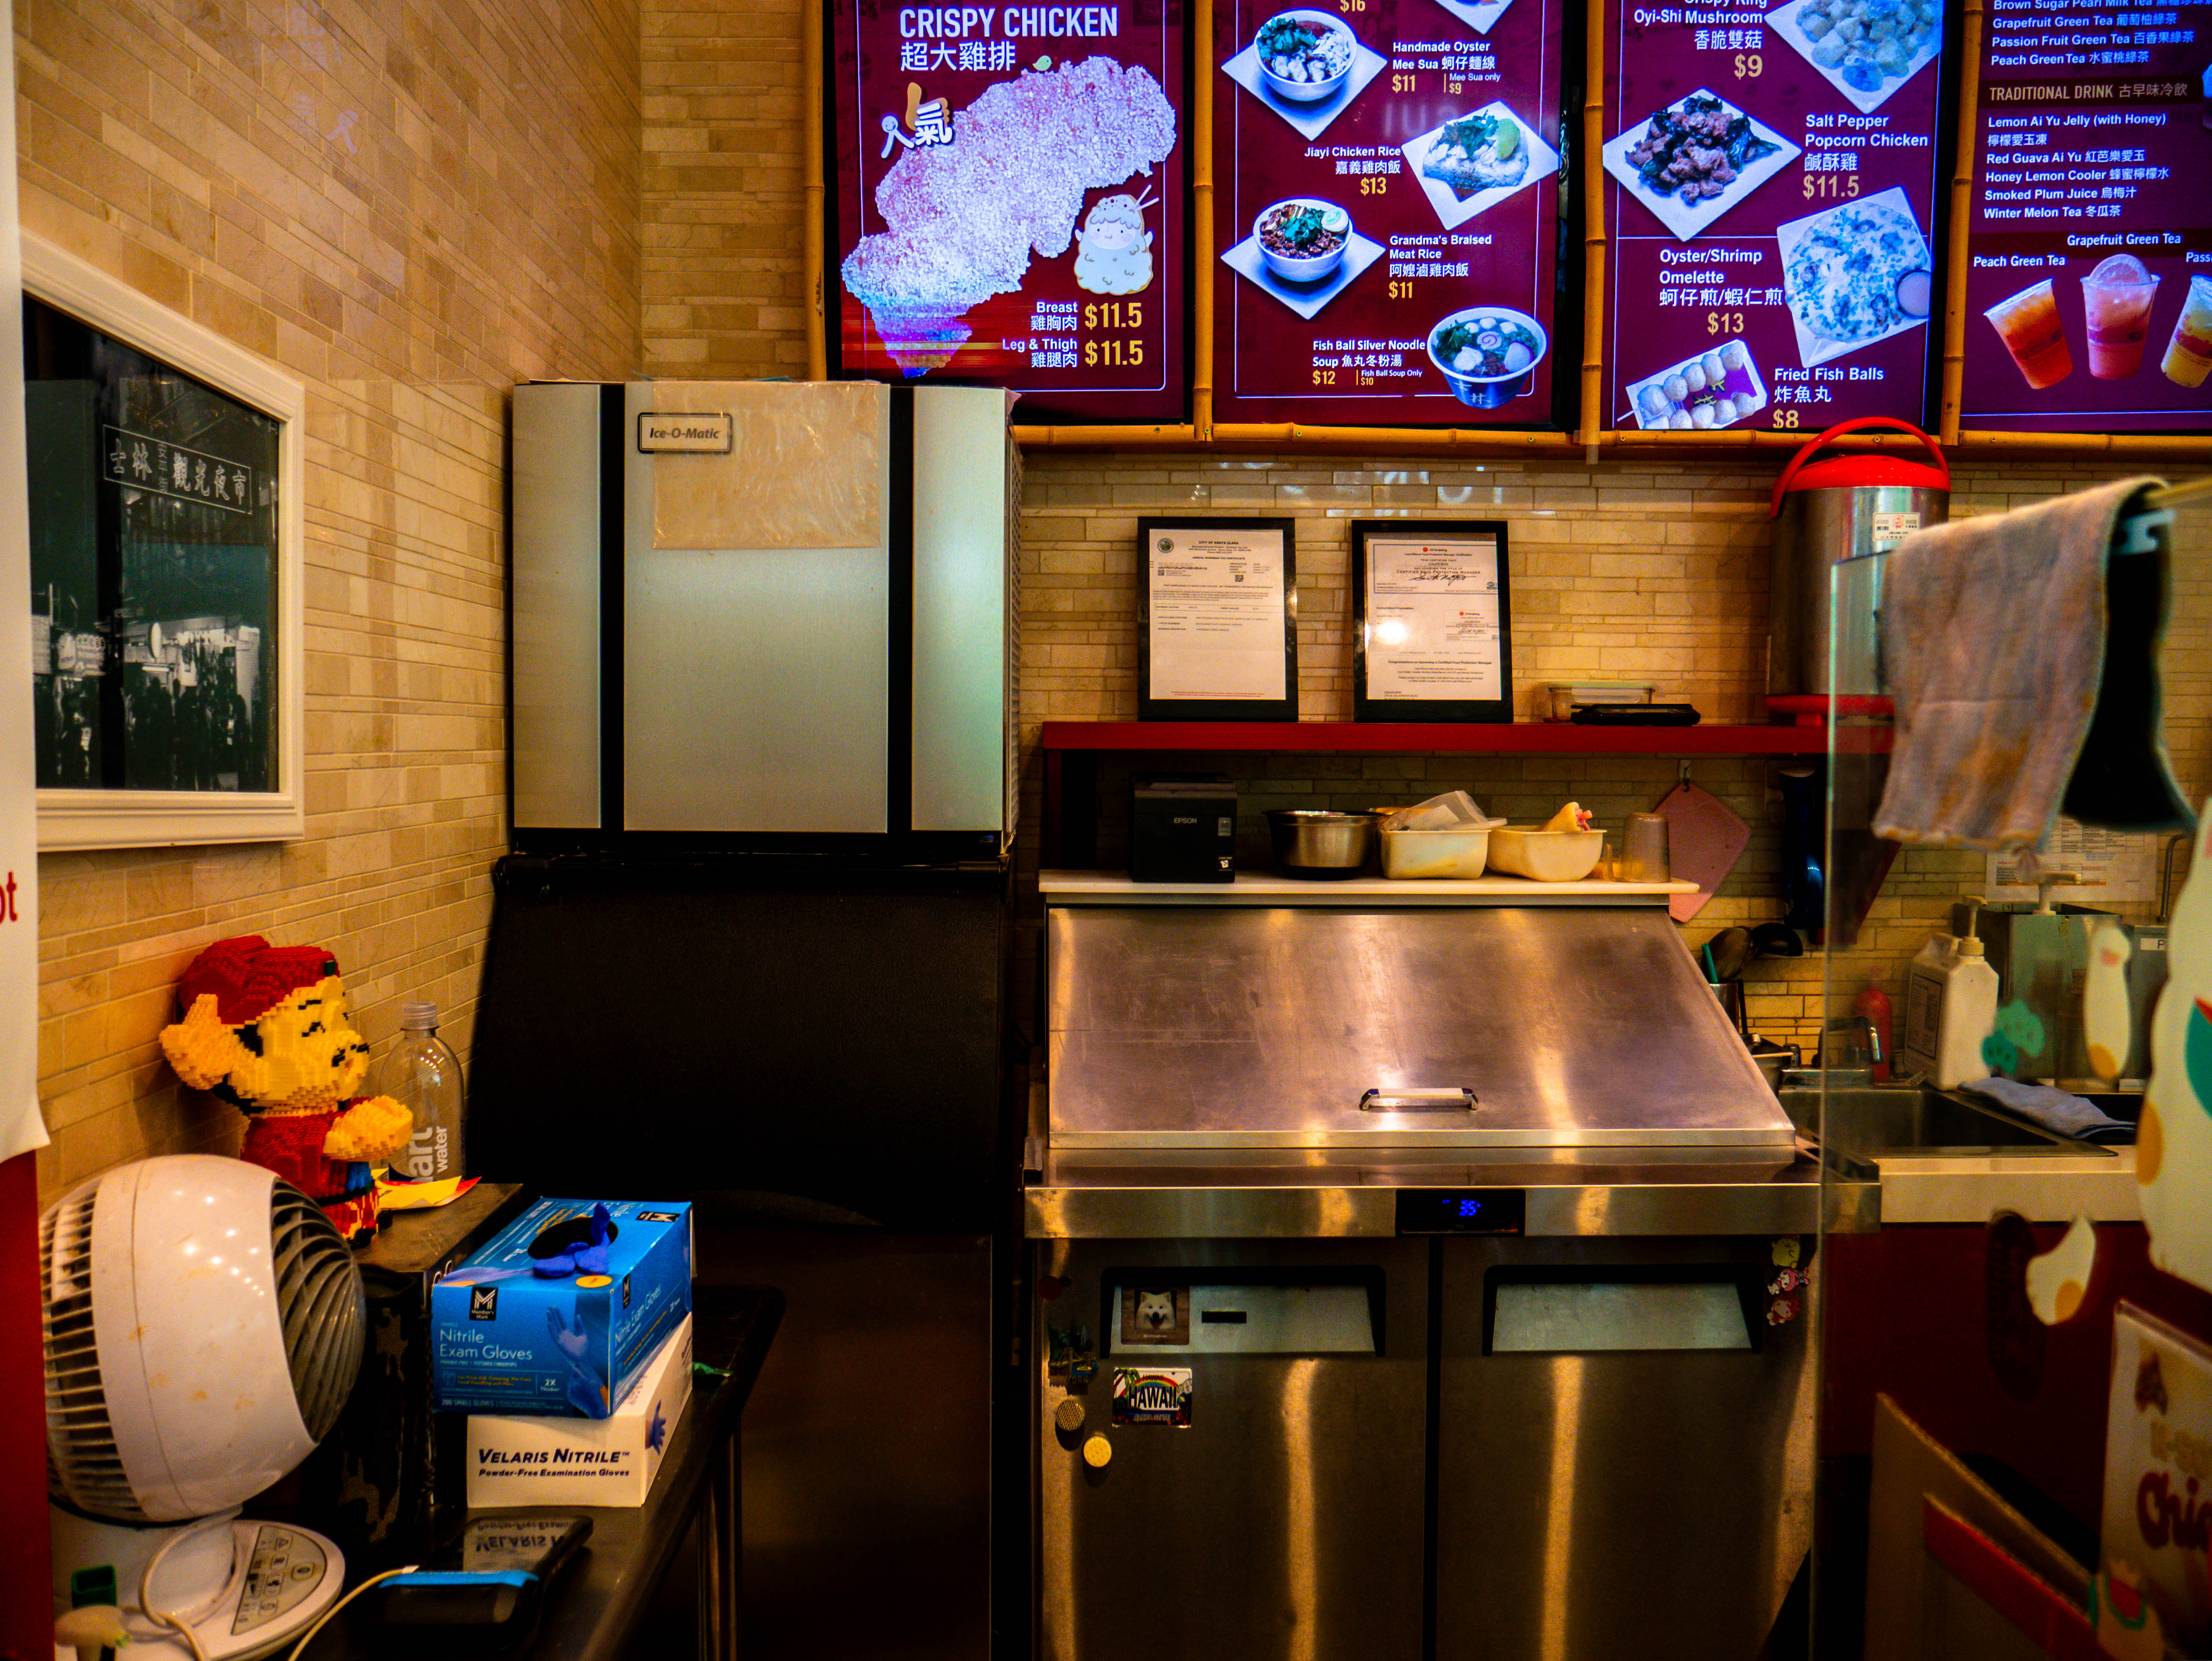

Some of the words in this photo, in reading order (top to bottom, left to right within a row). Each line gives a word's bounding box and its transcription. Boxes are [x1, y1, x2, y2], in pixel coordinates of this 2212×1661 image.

[1340, 0, 1365, 13] $16
[1994, 0, 2031, 10] Brown
[2035, 0, 2069, 11] Sugar
[901, 8, 995, 37] CRISPY
[1004, 7, 1117, 36] CHICKEN
[1634, 9, 1681, 26] Oyi-Shi
[1686, 11, 1762, 23] Mushroom
[1993, 17, 2051, 30] Grapefruit
[2055, 16, 2089, 26] Green
[2093, 16, 2112, 25] Tea
[2117, 13, 2176, 26] 葡萄柚綠茶
[1694, 30, 1762, 49] 香脆雙菇
[1992, 37, 2037, 46] Passion
[2042, 36, 2068, 45] Fruit
[2072, 35, 2106, 44] Green
[2111, 34, 2129, 44] Tea
[2135, 31, 2193, 44] 百香果綠茶
[1394, 42, 1451, 52] Handmade
[1454, 42, 1490, 54] Oyster
[901, 41, 1015, 71] 超大雞排
[1393, 59, 1414, 69] Mee
[1418, 59, 1438, 69] Sua
[1442, 56, 1495, 70] 蚵仔麵線
[1991, 55, 2026, 65] Peach
[2030, 54, 2064, 64] Green
[2066, 54, 2085, 63] Tea
[2090, 51, 2149, 64] 水蜜桃綠茶
[1735, 54, 1762, 79] $9
[1392, 74, 1415, 93] $11
[1485, 73, 1500, 82] only
[1449, 83, 1461, 94] $9
[1990, 86, 2069, 100] TRADITIONAL
[2075, 85, 2112, 98] DRINK
[2119, 83, 2187, 97] 古早味冷飲
[1806, 115, 1833, 127] Salt
[1838, 115, 1888, 130] Pepper
[1989, 118, 2027, 127] Lemon
[2031, 117, 2042, 126] Ai
[2046, 116, 2060, 125] Yu
[2064, 116, 2090, 127] Jelly
[2094, 115, 2121, 126] (with
[2125, 114, 2166, 125] Honey)
[881, 103, 952, 159] 人氣
[1806, 134, 1865, 149] Popcorn
[1871, 134, 1928, 146] Chicken
[1988, 133, 2047, 146] 檸檬愛玉凍
[1305, 147, 1329, 159] Jiayi
[1332, 147, 1375, 156] Chicken
[1379, 146, 1402, 156] Rice
[1987, 154, 2009, 163] Red
[2013, 153, 2049, 163] Guava
[2052, 152, 2064, 162] Ai
[2068, 152, 2081, 162] Yu
[2085, 150, 2145, 162] 紅芭樂愛玉
[1336, 160, 1400, 174] 嘉義雞肉飯
[1805, 152, 1858, 171] 鹹酥雞
[1986, 172, 2022, 184] Honey
[2026, 171, 2064, 181] Lemon
[2068, 170, 2107, 180] Cooler
[2110, 167, 2168, 180] 蜂蜜檸檬水
[1361, 178, 1386, 195] $13
[1803, 174, 1859, 200] $11.5
[1985, 190, 2031, 200] Smoked
[2035, 189, 2063, 199] Plum
[2067, 189, 2097, 198] Juice
[2101, 187, 2137, 198] 烏梅汁
[1984, 208, 2021, 218] Winter
[2025, 208, 2058, 217] Melon
[2063, 207, 2081, 216] Tea
[2086, 205, 2121, 217] 冬瓜茶
[1390, 235, 1447, 245] Grandma's
[1451, 235, 1491, 244] Braised
[2067, 235, 2123, 248] Grapefruit
[2126, 234, 2158, 244] Green
[2163, 234, 2180, 243] Tea
[1390, 249, 1415, 259] Meat
[1419, 249, 1441, 258] Rice
[1660, 249, 1762, 265] Oyster/Shrimp
[1974, 256, 2006, 267] Peach
[2011, 256, 2042, 266] Green
[2047, 255, 2065, 265] Tea
[1390, 263, 1469, 277] 阿嬤滷雞肉飯
[1660, 271, 1724, 283] Omelette
[1389, 281, 1412, 299] $11
[1660, 288, 1783, 306] 蚵仔煎/蝦仁煎
[1037, 302, 1078, 312] Breast
[1031, 315, 1076, 330] 雞胸肉
[1085, 303, 1142, 329] $11.5
[1708, 312, 1743, 335] $13
[1003, 339, 1024, 353] Leg
[1029, 339, 1038, 350] &
[1040, 339, 1077, 353] Thigh
[1314, 341, 1333, 350] Fish
[1336, 340, 1354, 350] Ball
[1358, 340, 1386, 350] Silver
[1389, 340, 1425, 350] Noodle
[1032, 351, 1077, 368] 雞腿肉
[1085, 340, 1143, 366] $11.5
[1313, 357, 1338, 368] Soup
[1342, 355, 1402, 367] 魚丸冬粉湯
[1313, 370, 1335, 385] $12
[1361, 377, 1374, 386] $10
[1775, 368, 1809, 380] Fried
[1815, 368, 1843, 380] Fish
[1850, 368, 1883, 380] Balls
[1774, 386, 1831, 402] 炸魚丸
[1773, 409, 1798, 428] $8
[650, 427, 720, 439] Ice-O-Matic
[434, 1127, 448, 1174] water
[440, 1328, 484, 1343] Nitrile
[440, 1344, 477, 1358] Exam
[482, 1345, 533, 1360] Gloves
[1129, 1386, 1176, 1408] HAWAII
[479, 1449, 549, 1463] VELARIS
